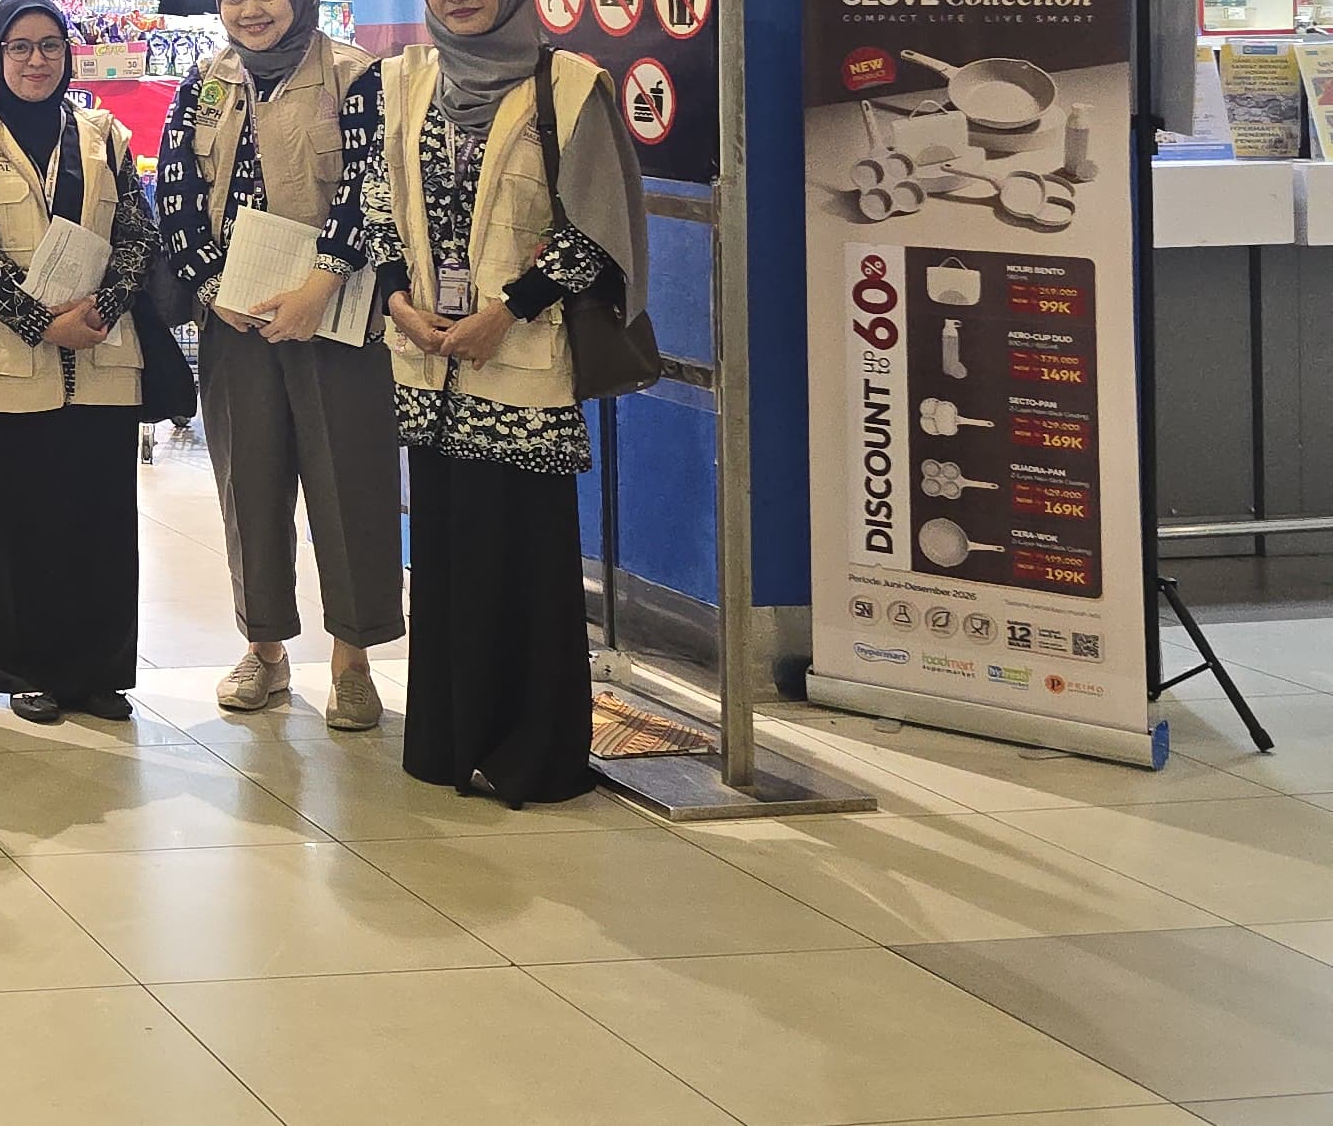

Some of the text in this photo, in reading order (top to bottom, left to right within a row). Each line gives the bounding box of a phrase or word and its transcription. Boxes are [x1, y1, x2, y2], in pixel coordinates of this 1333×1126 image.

[842, 14, 918, 23] COMPACT
[1035, 14, 1095, 24] SMART
[848, 58, 884, 75] NEW
[1039, 300, 1070, 314] 99K
[1041, 368, 1082, 383] 149K
[852, 254, 899, 555] DISCOUNT up to 60%
[1009, 397, 1057, 409] SECTO-PAN
[1042, 433, 1083, 450] 169K
[1010, 463, 1066, 477] QUADRA-PAN
[1044, 500, 1084, 517] 169K
[848, 574, 881, 588] Periode
[1045, 567, 1085, 585] 199K
[1007, 624, 1032, 642] 12
[856, 646, 907, 662] hypermart
[922, 652, 975, 671] foodmart
